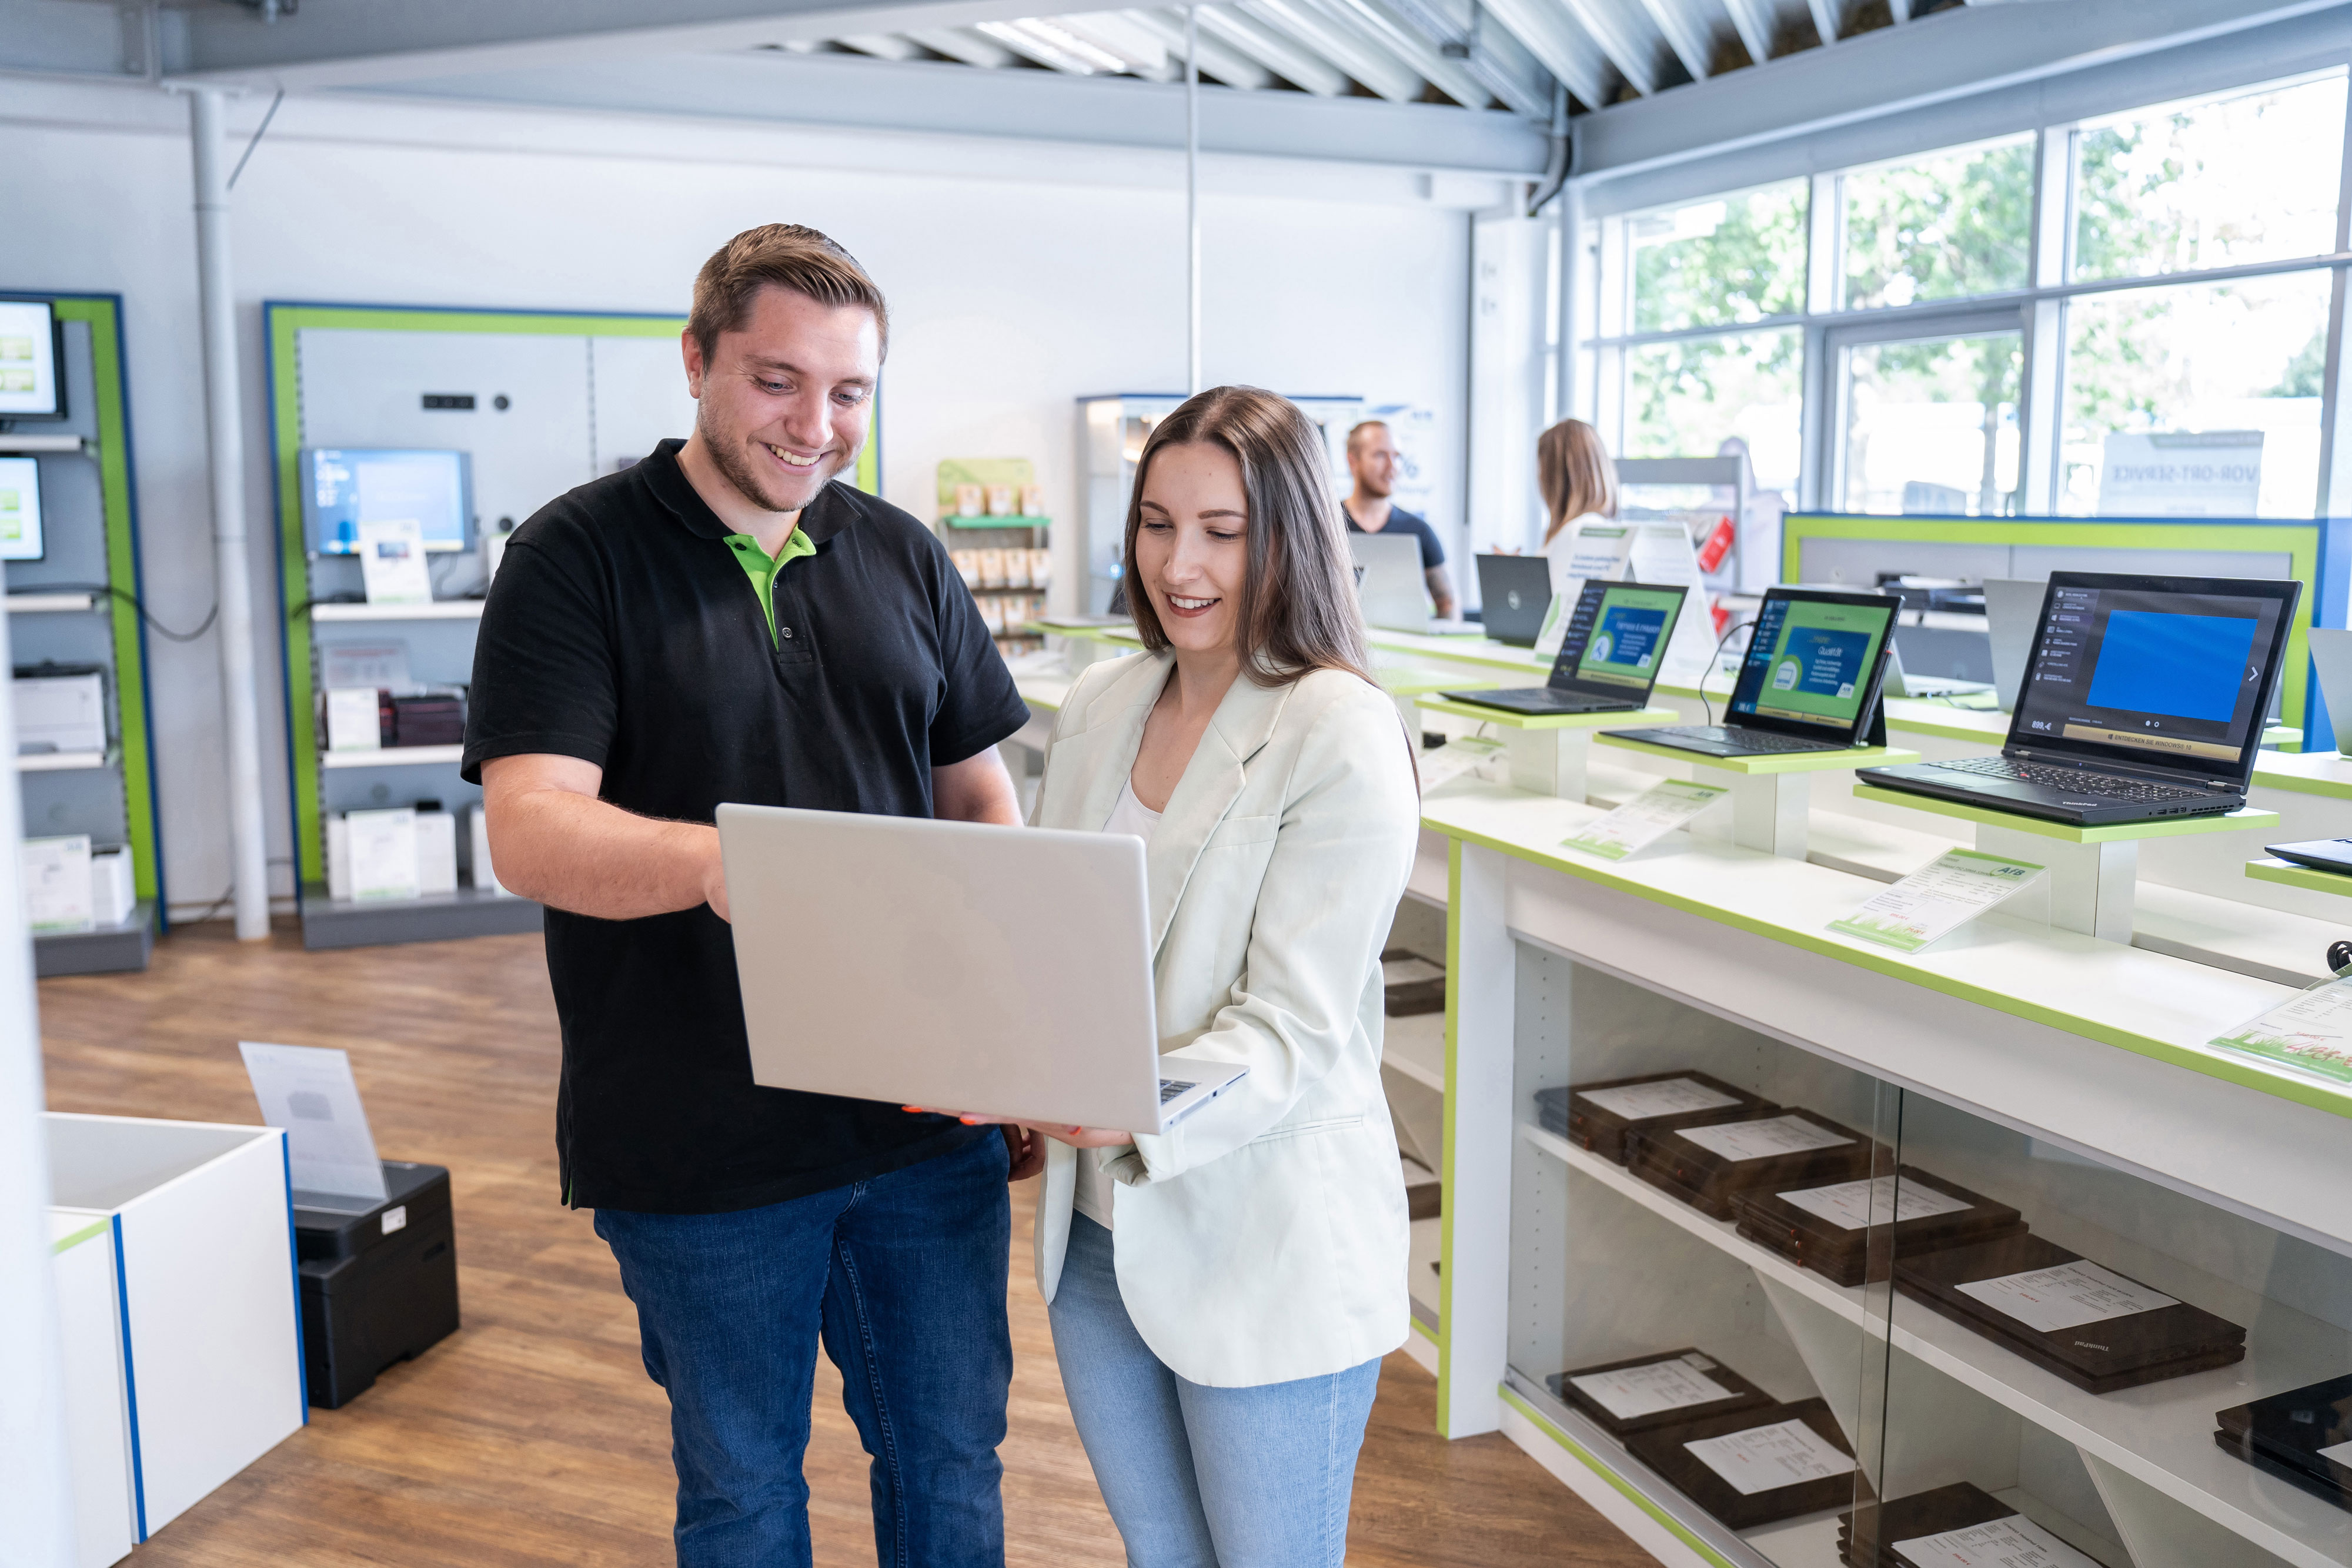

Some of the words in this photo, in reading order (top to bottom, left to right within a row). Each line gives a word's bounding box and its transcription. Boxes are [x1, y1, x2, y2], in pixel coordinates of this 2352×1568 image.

[1818, 646, 1842, 657] Qualität
[2114, 734, 2145, 744] ENTDECKEN
[1997, 867, 2026, 876] AfB
[2074, 1340, 2110, 1352] ThinkPad
